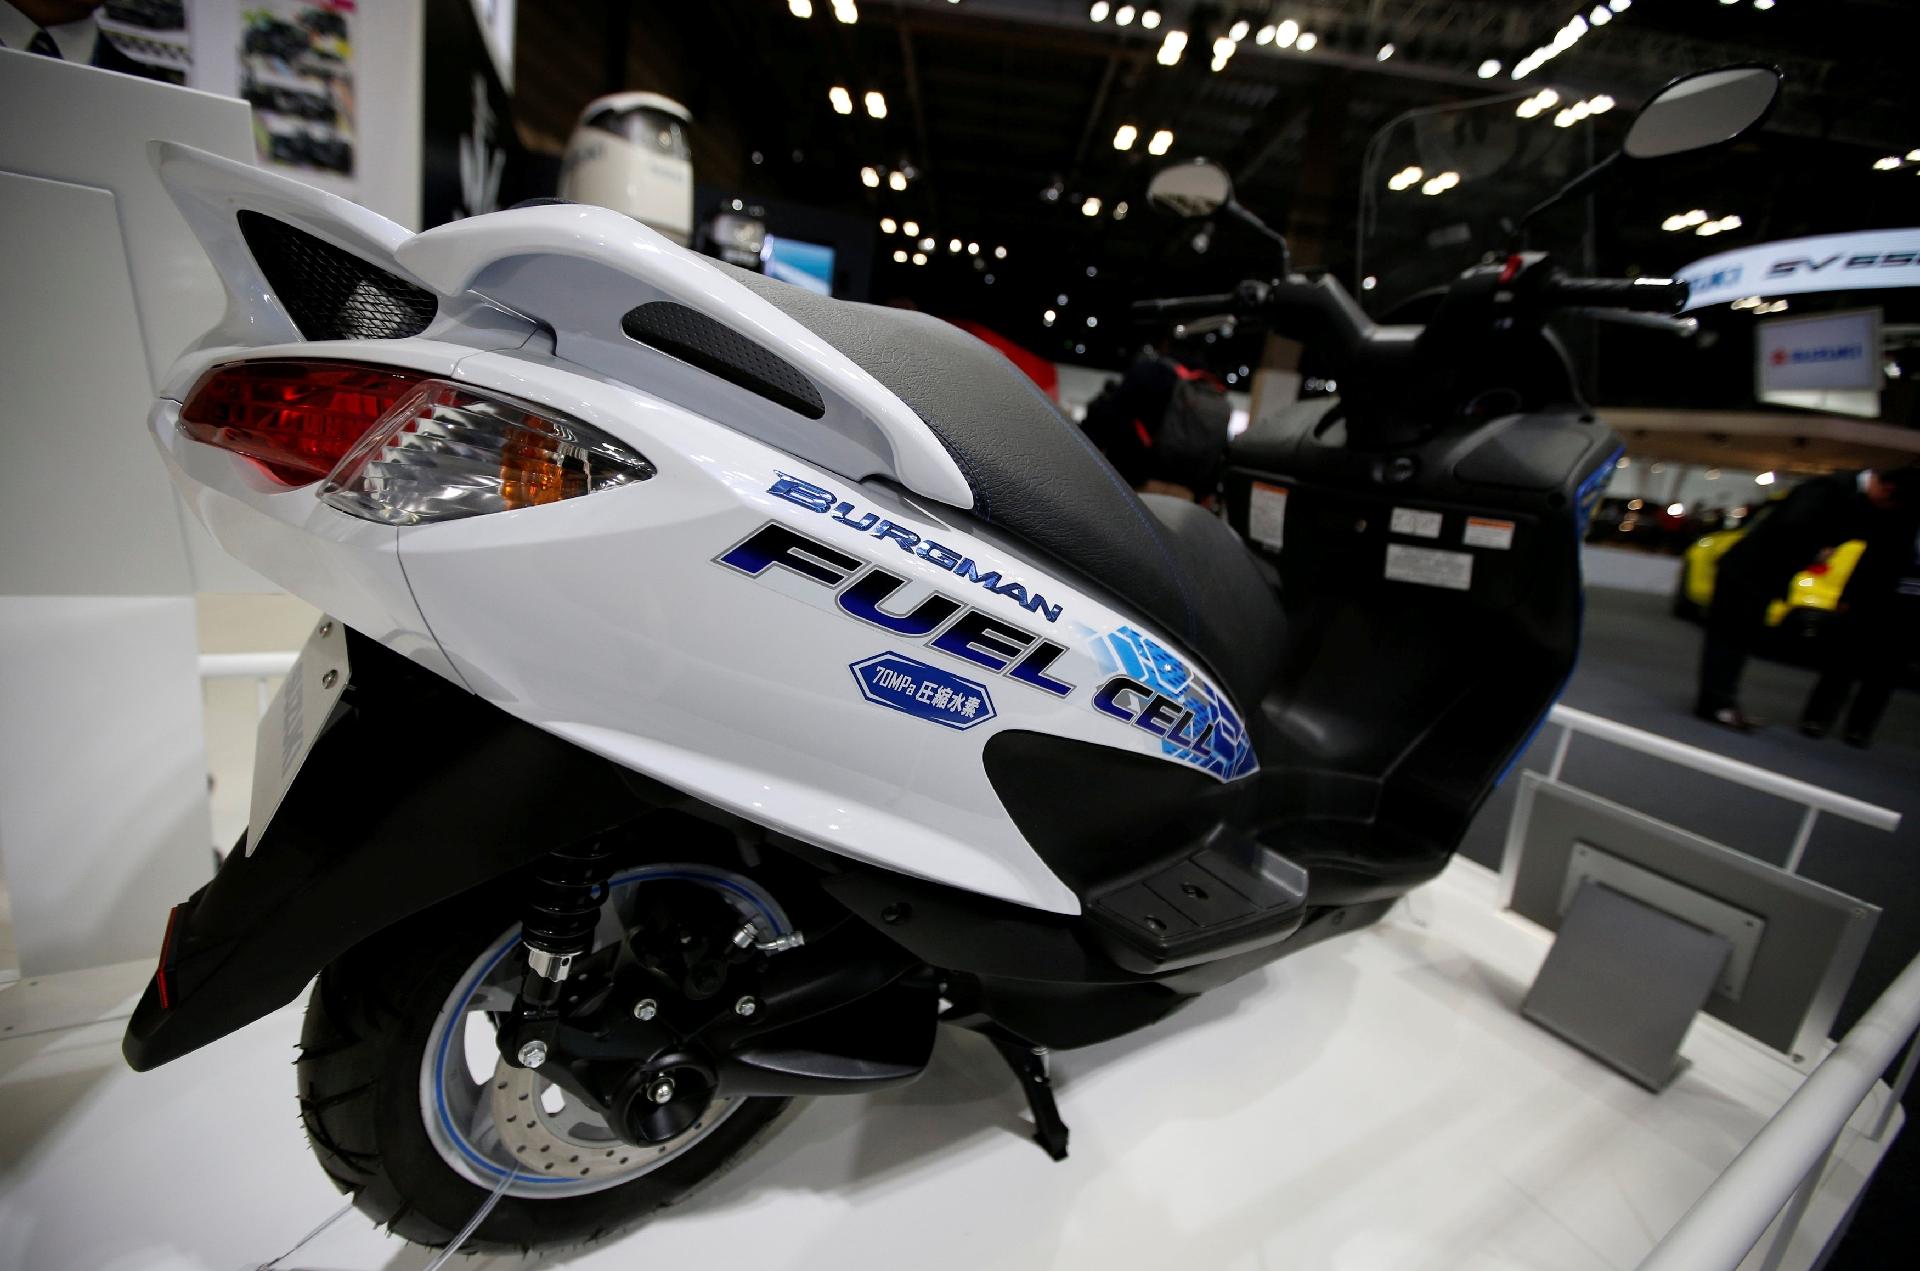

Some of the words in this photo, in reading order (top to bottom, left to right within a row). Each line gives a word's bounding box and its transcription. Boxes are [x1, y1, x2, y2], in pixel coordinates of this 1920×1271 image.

[766, 469, 1064, 623] BURGMAN
[712, 520, 1077, 699] FUEL
[1092, 674, 1215, 758] CELL
[872, 666, 917, 696] 70MPa
[915, 680, 981, 718] 圧縮水素
